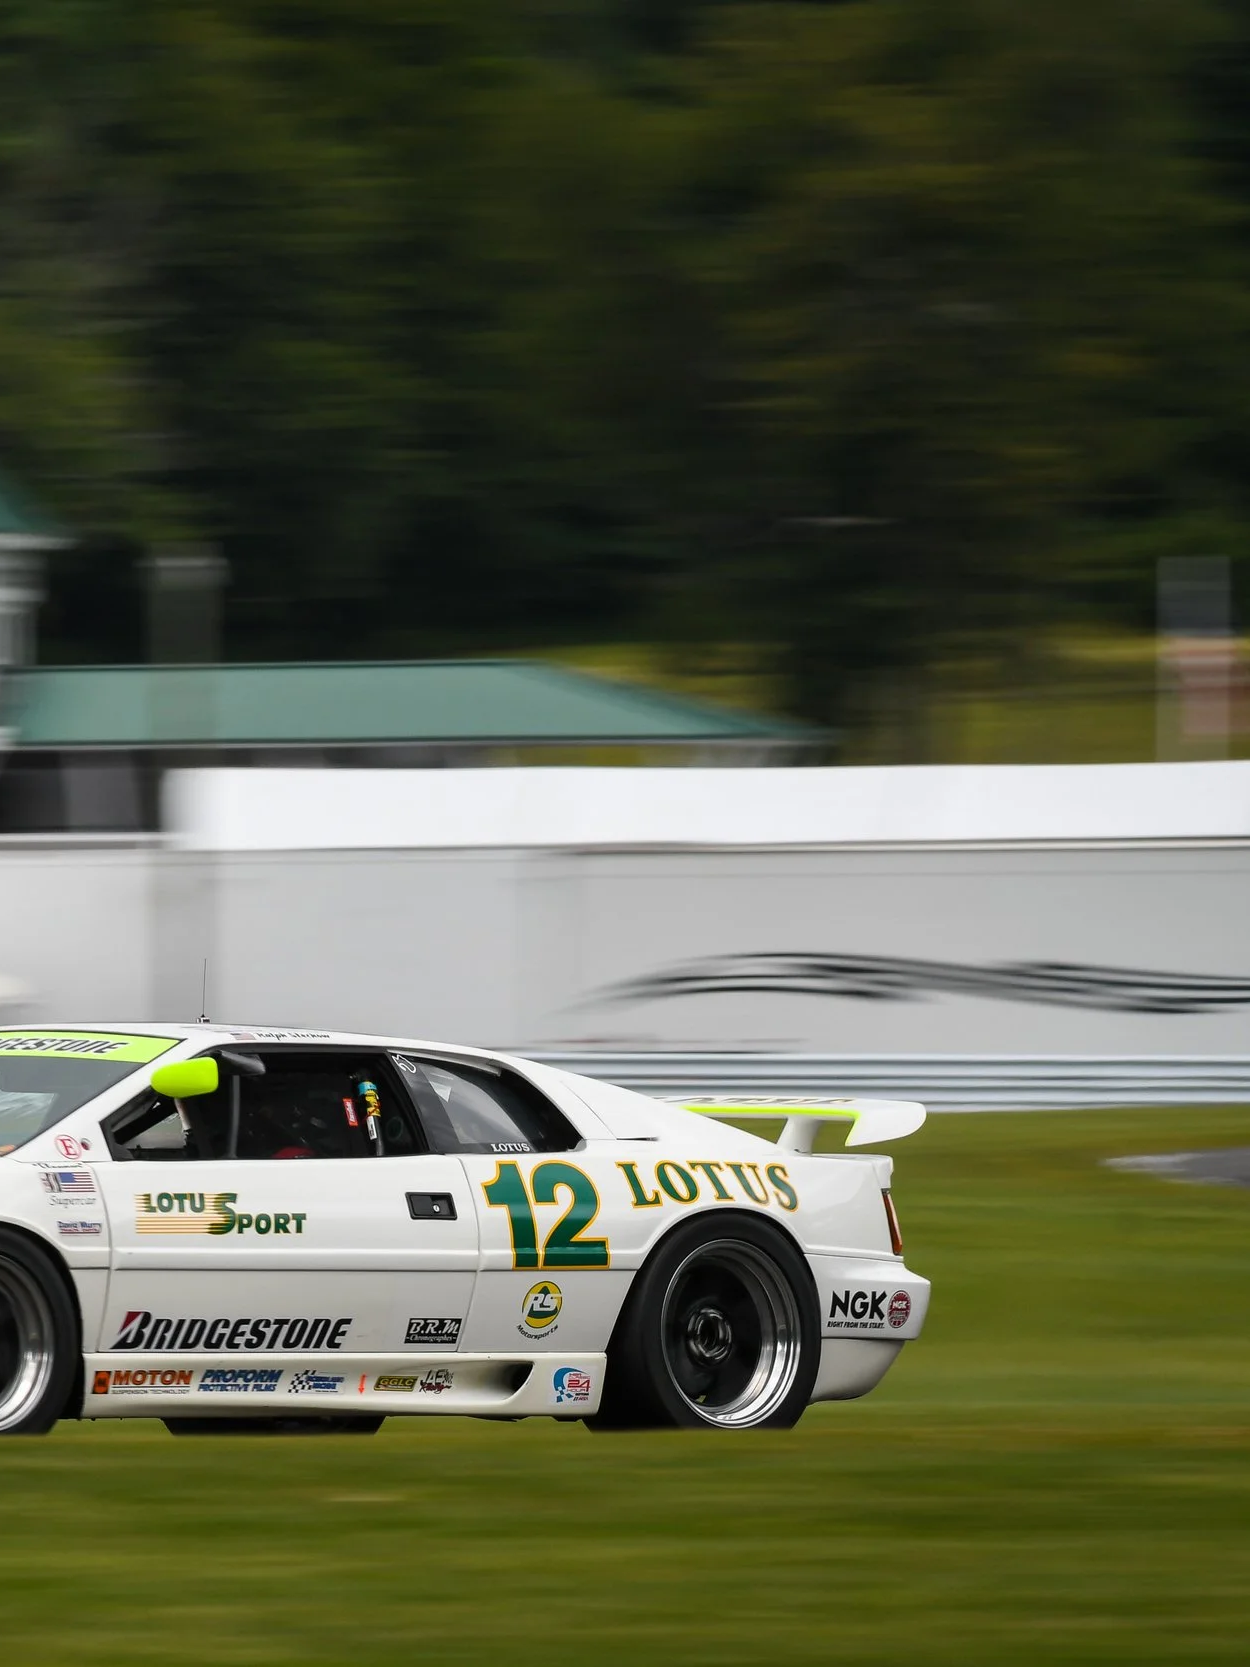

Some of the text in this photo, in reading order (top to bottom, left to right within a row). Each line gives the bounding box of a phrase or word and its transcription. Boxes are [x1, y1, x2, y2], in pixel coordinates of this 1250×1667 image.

[256, 1032, 287, 1041] Ralph
[58, 1138, 78, 1156] E
[491, 1142, 530, 1153] LOTUS
[615, 1160, 799, 1212] LOTUS
[481, 1160, 610, 1270] 12
[523, 1293, 562, 1320] RS
[829, 1290, 887, 1320] NGK
[892, 1300, 908, 1308] NGK
[110, 1311, 352, 1349] BRIDGESTONE
[859, 1321, 869, 1329] THE
[112, 1369, 193, 1385] MOTON
[200, 1369, 284, 1383] PROFORM
[380, 1378, 414, 1386] GGLC
[198, 1383, 277, 1392] PROTECTIVE FILMS
[567, 1379, 591, 1393] 24
